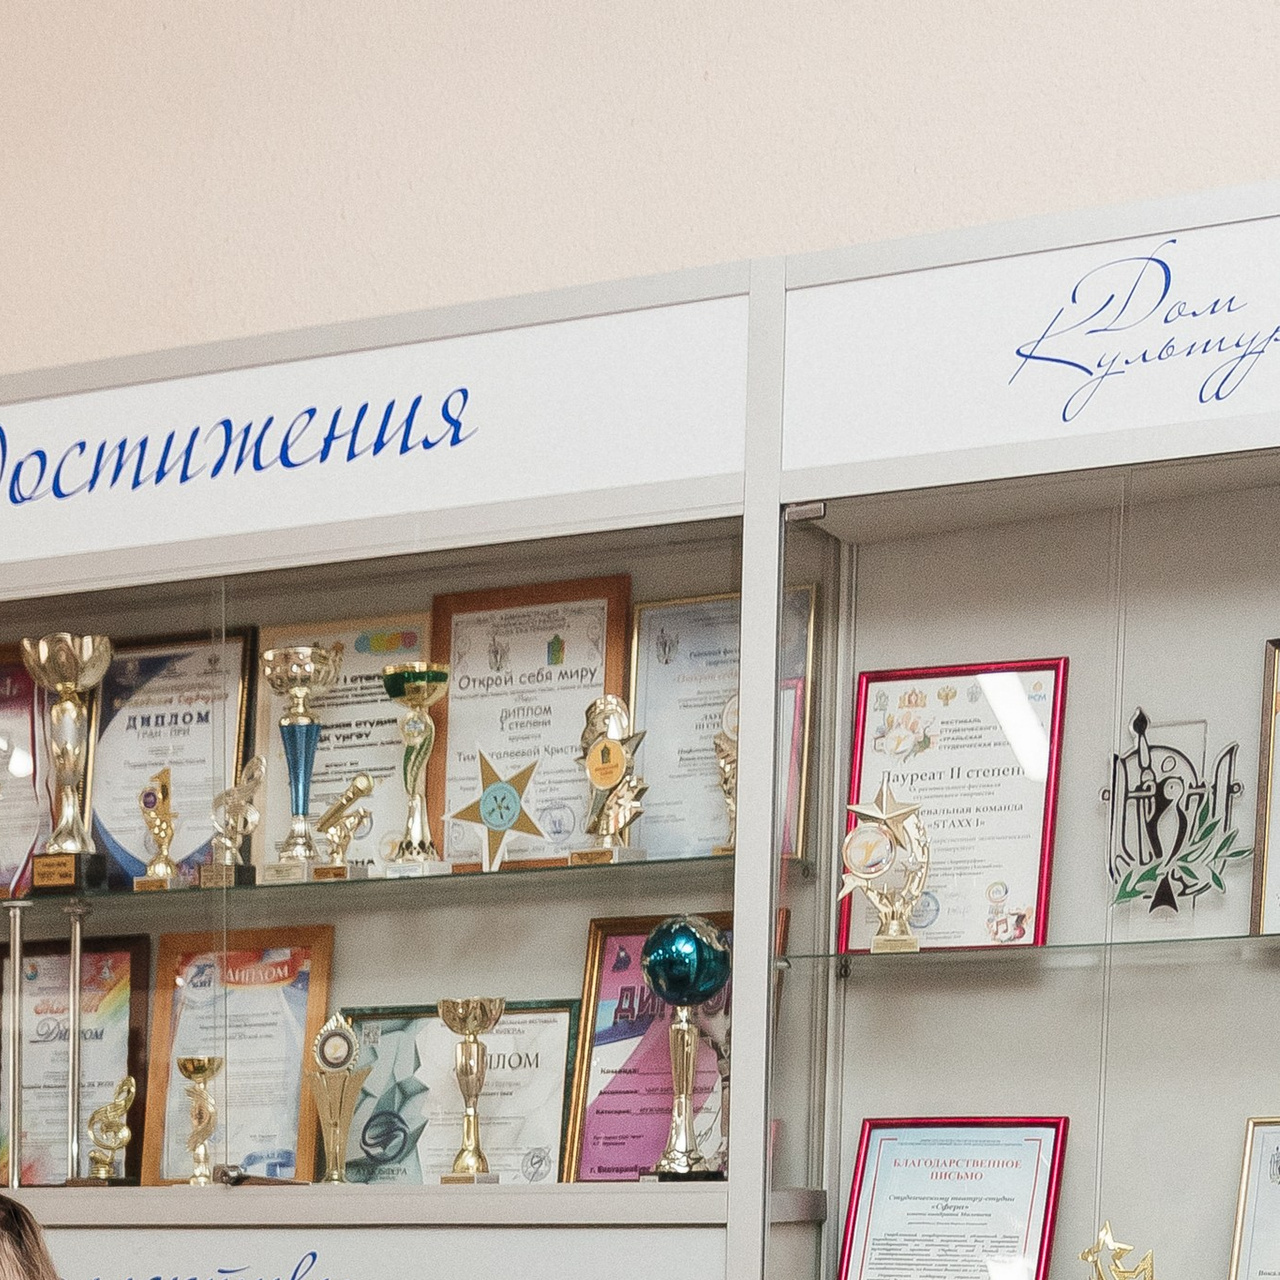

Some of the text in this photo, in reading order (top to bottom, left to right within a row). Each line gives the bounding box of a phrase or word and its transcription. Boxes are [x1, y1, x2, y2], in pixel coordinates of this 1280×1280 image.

[1071, 239, 1248, 335] Дом
[1008, 307, 1280, 422] Культур
[458, 666, 598, 691] Открой себя миру
[126, 710, 210, 731] ДИПЛОМ
[500, 705, 552, 723] ДИПЛОМ
[508, 718, 551, 730] степени
[881, 765, 1026, 787] Лауреат II степен
[975, 803, 1023, 814] команда
[893, 1158, 1022, 1169] БЛАГОДАРСТВЕННОЕ
[929, 1171, 984, 1181] ПИСЬМО
